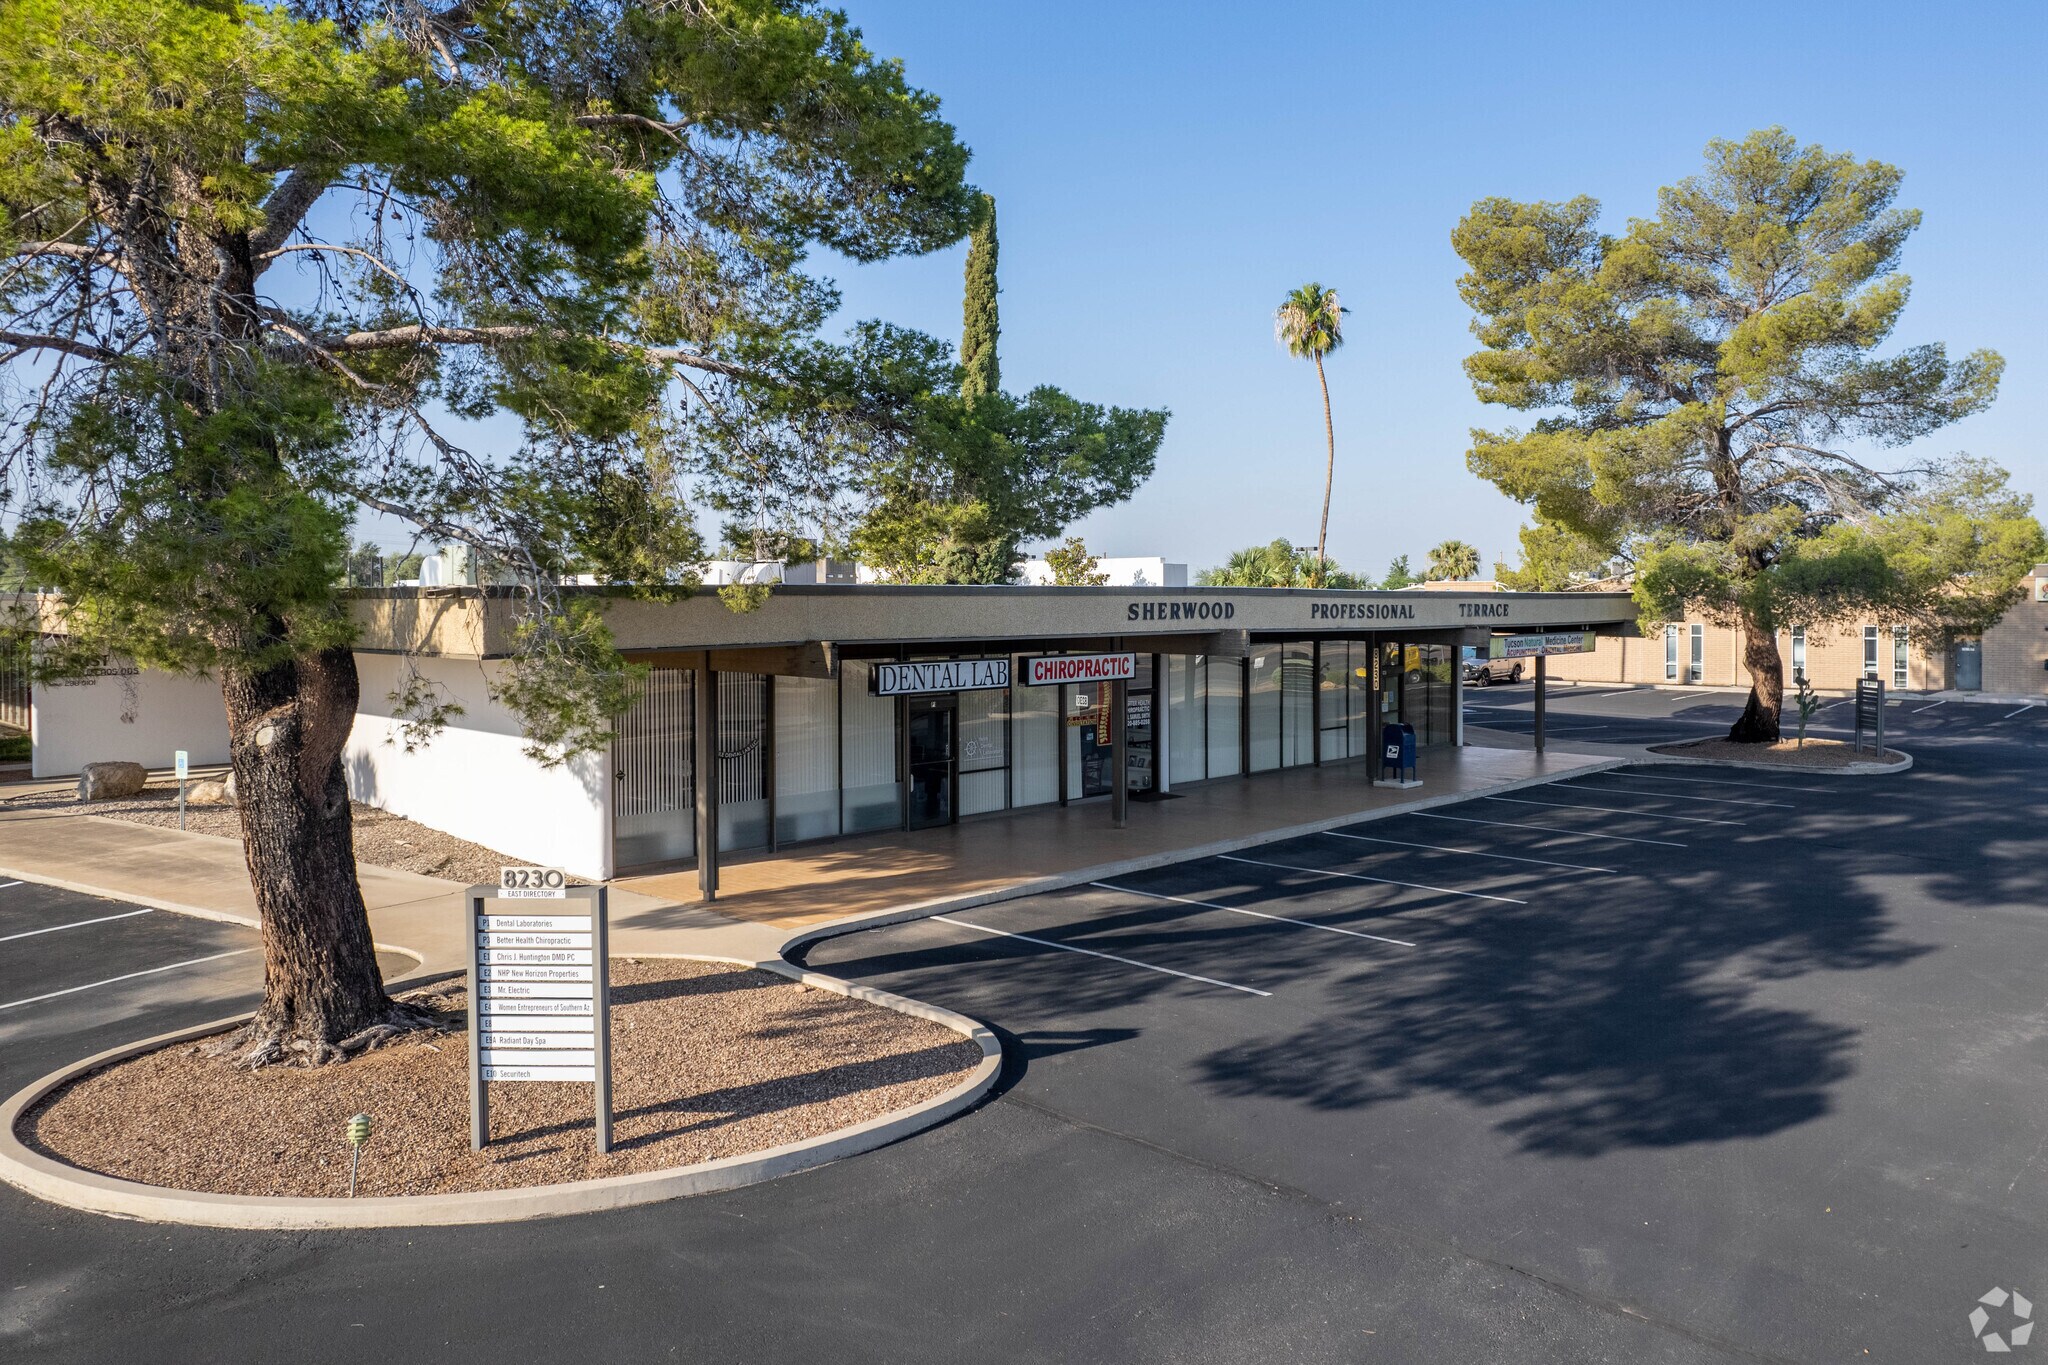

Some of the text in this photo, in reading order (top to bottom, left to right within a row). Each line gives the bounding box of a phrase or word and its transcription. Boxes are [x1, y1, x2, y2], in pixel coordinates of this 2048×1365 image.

[1127, 602, 1509, 621] SHERWOOD PROFESSIONAL TERRACE
[1504, 634, 1583, 648] Tucson Natural Medicine Center
[1034, 656, 1130, 680] CHIROPRACTIC
[881, 661, 1007, 692] DENTAL LAB
[503, 869, 564, 888] 8230
[523, 890, 556, 898] DIRECTORY
[496, 919, 515, 927] Dental
[516, 919, 553, 928] Laboratories
[535, 937, 572, 945] Chiropractic
[497, 953, 512, 961] Chris
[519, 953, 551, 962] Huntington
[567, 953, 576, 961] PC
[498, 969, 510, 977] NHP
[512, 969, 523, 977] New
[525, 969, 547, 977] Horizon
[549, 969, 579, 978] Properties
[508, 986, 530, 994] Electric
[517, 1004, 553, 1012] Entrepreneurs
[554, 1003, 559, 1011] of
[560, 1003, 582, 1011] Southern
[499, 1036, 522, 1044] Radiant
[523, 1037, 534, 1045] Day
[535, 1037, 546, 1045] Spa
[500, 1070, 531, 1078] Securitech
